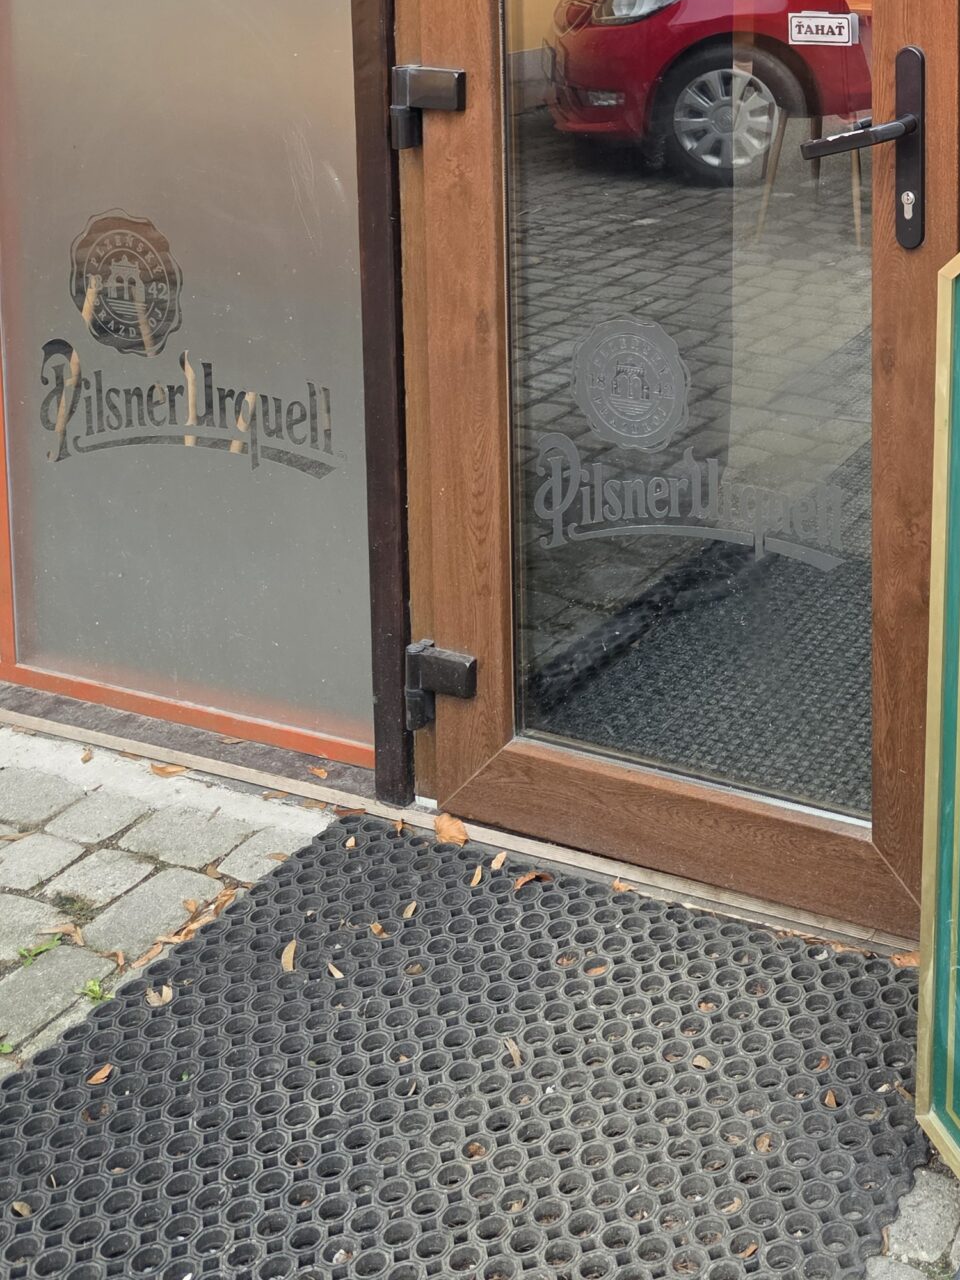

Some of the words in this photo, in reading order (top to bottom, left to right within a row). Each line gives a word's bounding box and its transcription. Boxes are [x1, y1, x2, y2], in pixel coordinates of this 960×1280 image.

[795, 21, 845, 36] ŤAHAŤ
[148, 281, 168, 299] 42
[40, 338, 185, 462] Pilsner
[180, 350, 335, 470] Urquell
[534, 432, 690, 550] Pilsner
